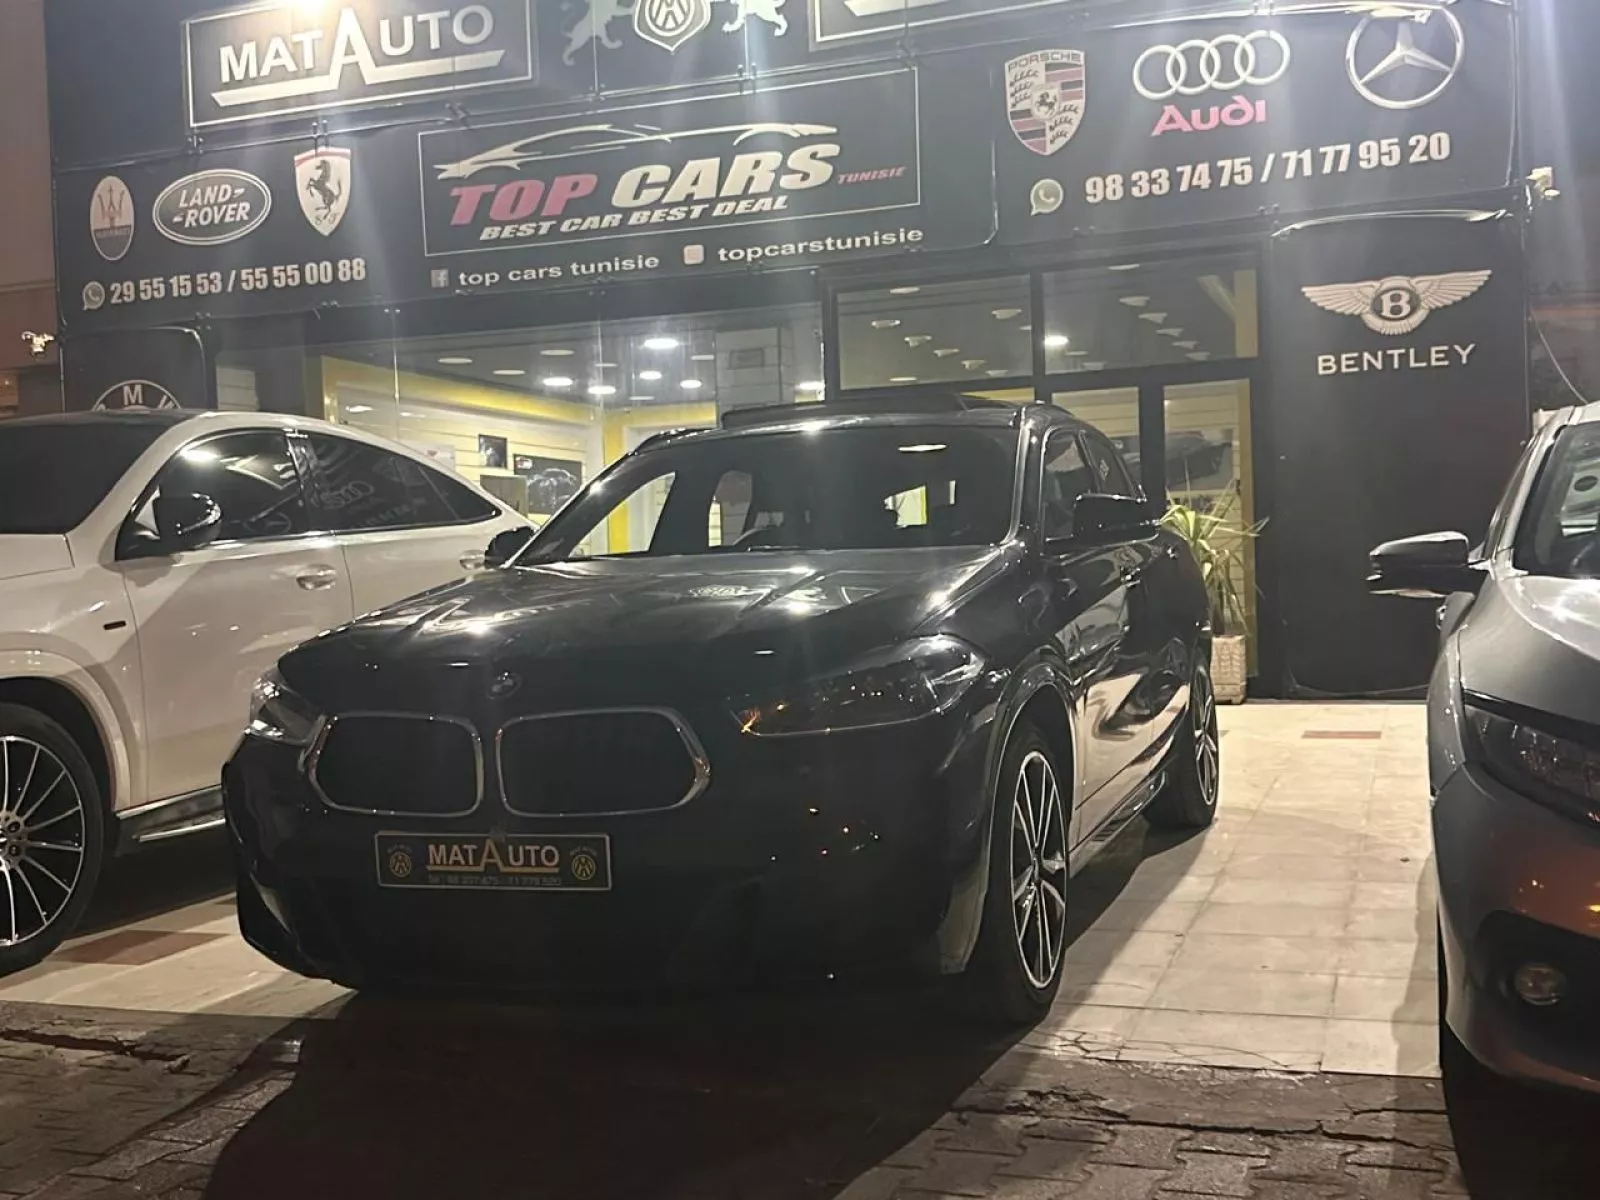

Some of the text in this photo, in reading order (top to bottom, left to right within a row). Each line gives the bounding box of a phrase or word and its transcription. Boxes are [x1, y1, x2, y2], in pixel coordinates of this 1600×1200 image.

[1007, 51, 1081, 72] PORSCHE
[1151, 94, 1266, 137] Audi
[450, 143, 908, 226] TOP CARS TUNISIE
[1084, 131, 1451, 204] 98 33 74 75 / 71 77 95 20
[480, 195, 788, 241] BEST CAR BEST DEAL
[718, 228, 924, 263] topcarstunisie
[110, 257, 366, 304] 29 55 15 53 / 55 55 00 88
[459, 254, 660, 288] top cars tunisie
[1380, 289, 1411, 319] B
[1317, 343, 1476, 376] BENTLEY
